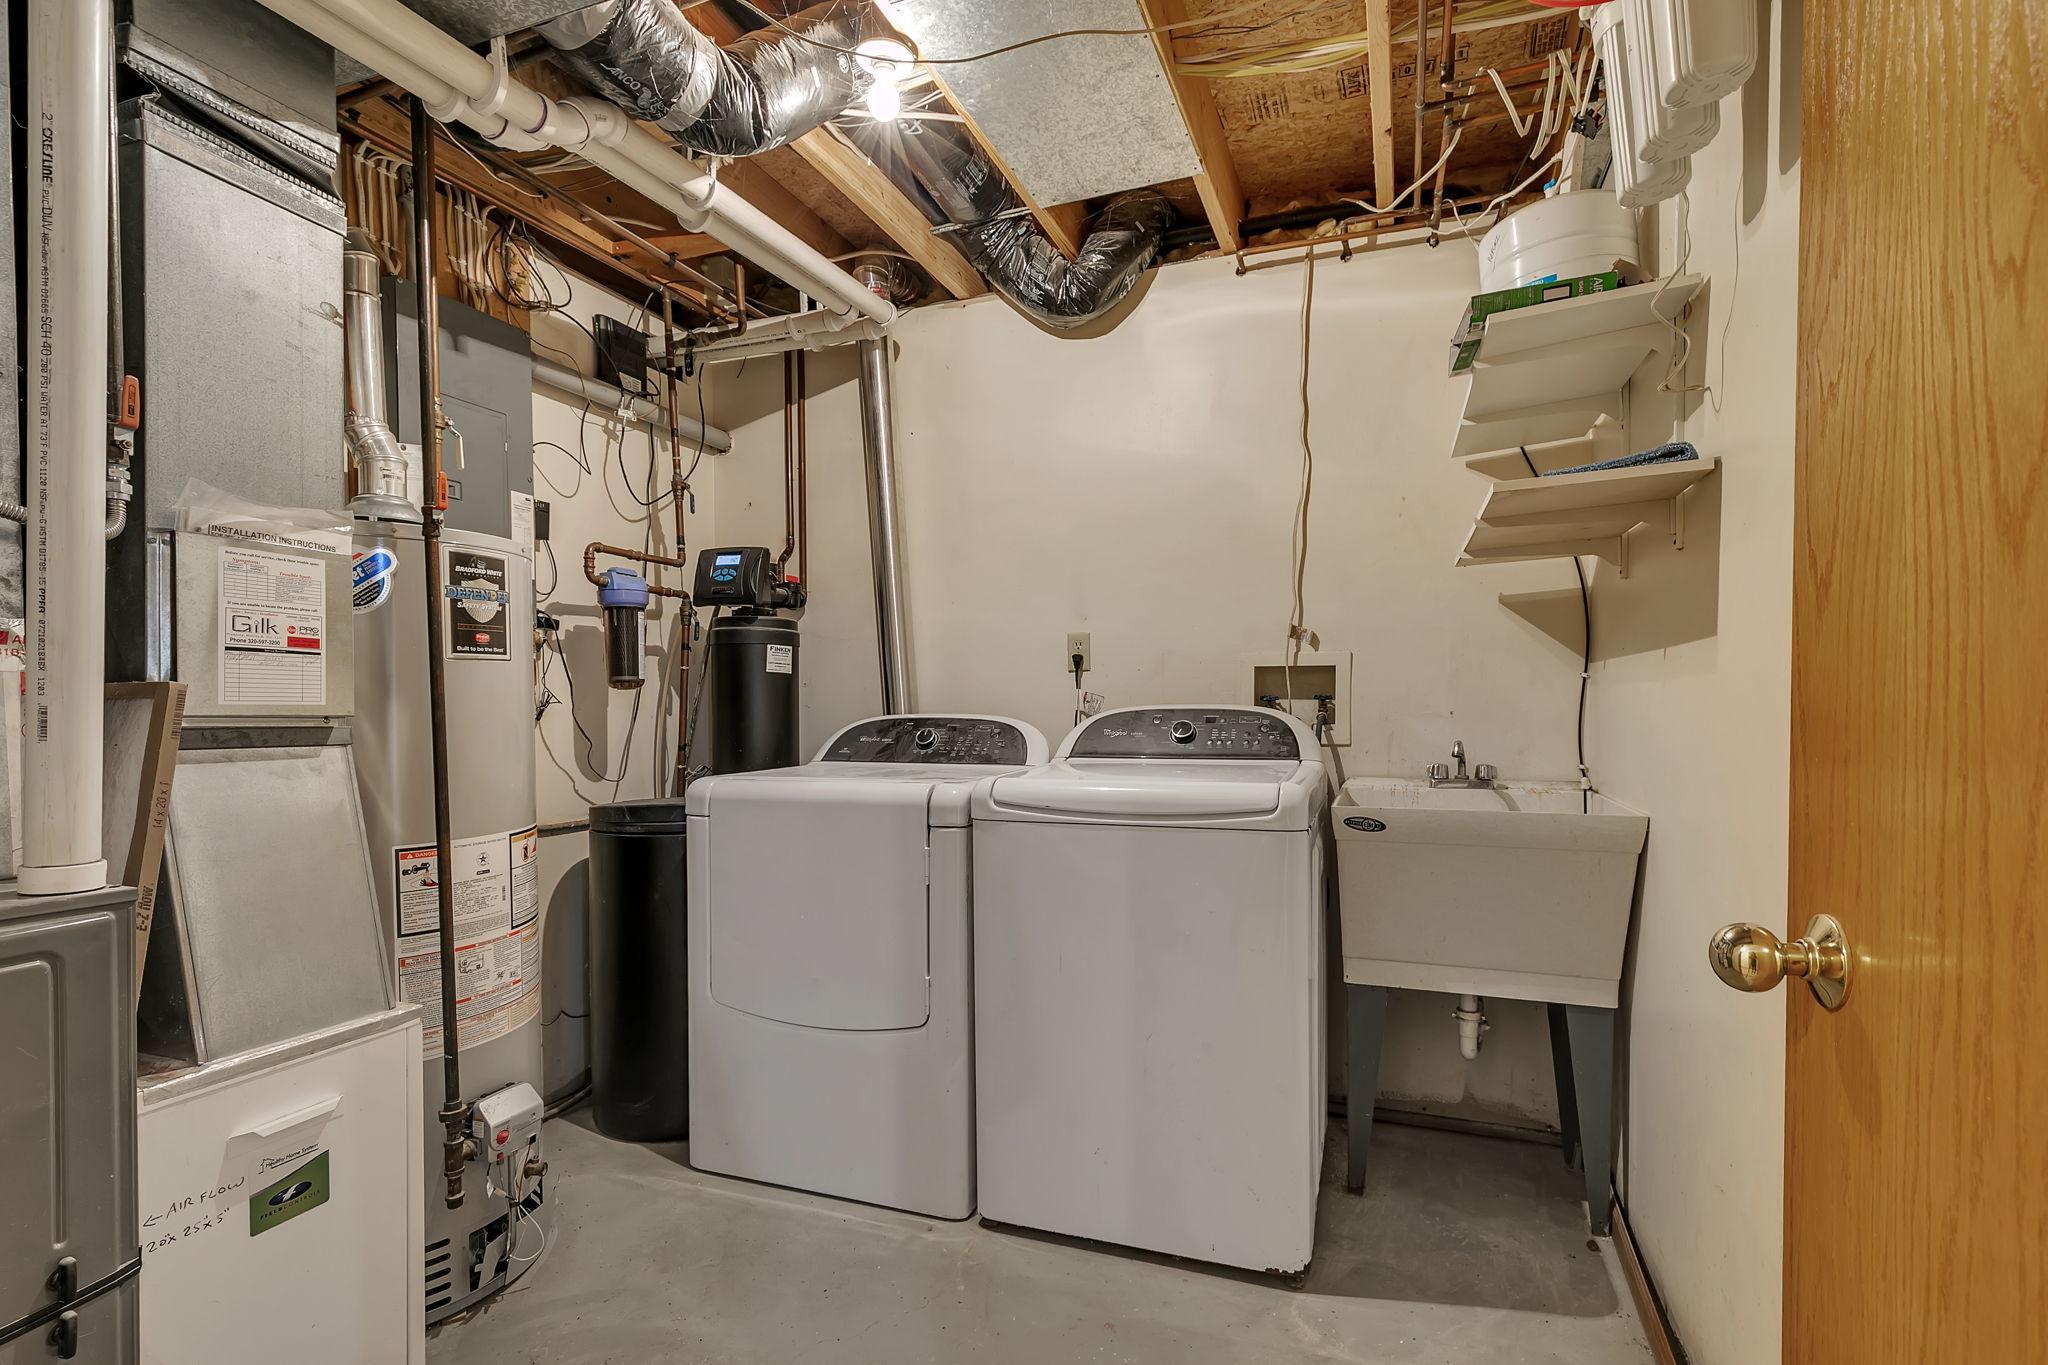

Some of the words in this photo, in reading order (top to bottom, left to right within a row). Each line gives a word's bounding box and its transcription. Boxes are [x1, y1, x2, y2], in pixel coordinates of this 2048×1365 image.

[42, 189, 50, 205] PVC
[41, 206, 53, 231] DWV
[41, 265, 49, 287] ASTM
[41, 316, 53, 338] SCH
[41, 341, 53, 356] 40
[40, 376, 48, 389] PSI
[40, 391, 48, 416] WATER
[40, 418, 48, 429] AT
[39, 450, 47, 466] PVC
[39, 467, 47, 486] 1120
[38, 526, 47, 546] ASTM
[211, 524, 277, 542] INSTALLATION
[278, 536, 337, 553] INSTRUCTIONS
[455, 566, 487, 575] BRADFORD
[487, 569, 503, 577] WHITE
[445, 586, 510, 604] DEFENDER
[232, 614, 279, 635] Gilk
[299, 626, 319, 634] PRO
[415, 850, 438, 858] DANGE
[265, 1155, 285, 1169] Healthy
[285, 1149, 301, 1161] Home
[301, 1143, 319, 1156] System
[167, 1197, 195, 1220] AIR
[200, 1176, 245, 1204] FLOW
